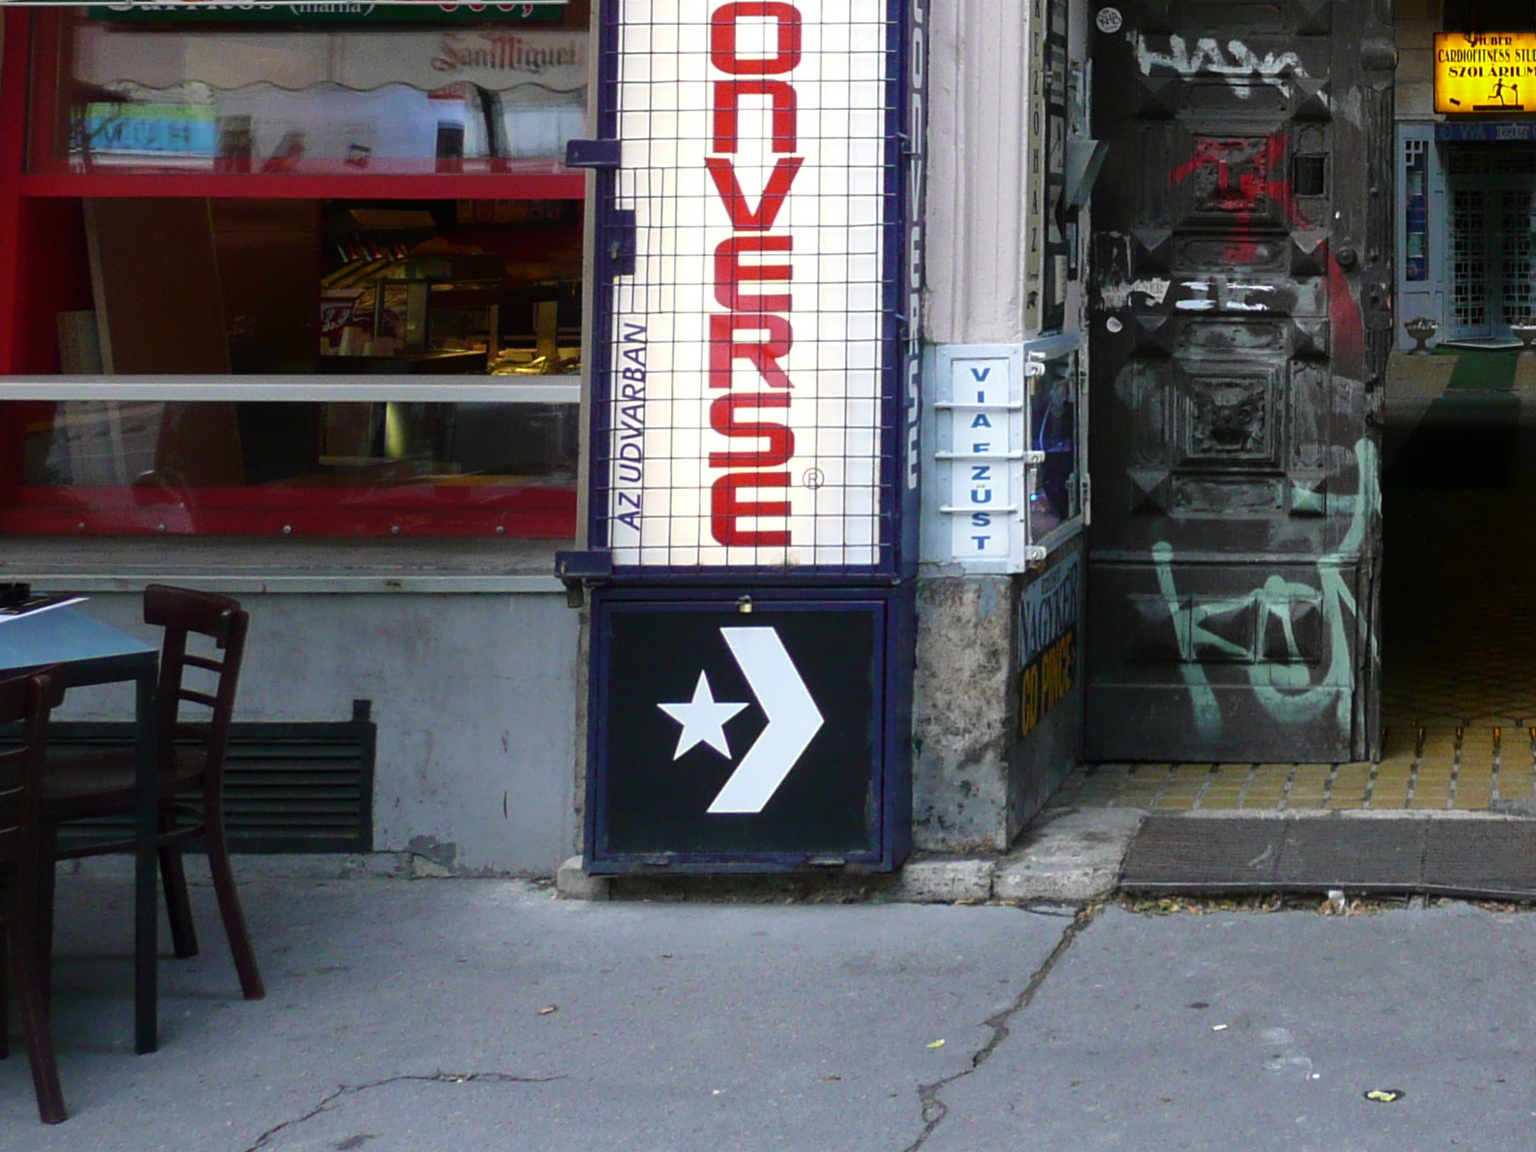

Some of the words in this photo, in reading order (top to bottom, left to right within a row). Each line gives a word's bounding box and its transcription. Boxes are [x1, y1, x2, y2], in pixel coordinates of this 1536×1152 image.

[1438, 48, 1510, 63] CARDIOFITNESS
[619, 323, 648, 483] UDVARBAN
[618, 491, 642, 531] AZ
